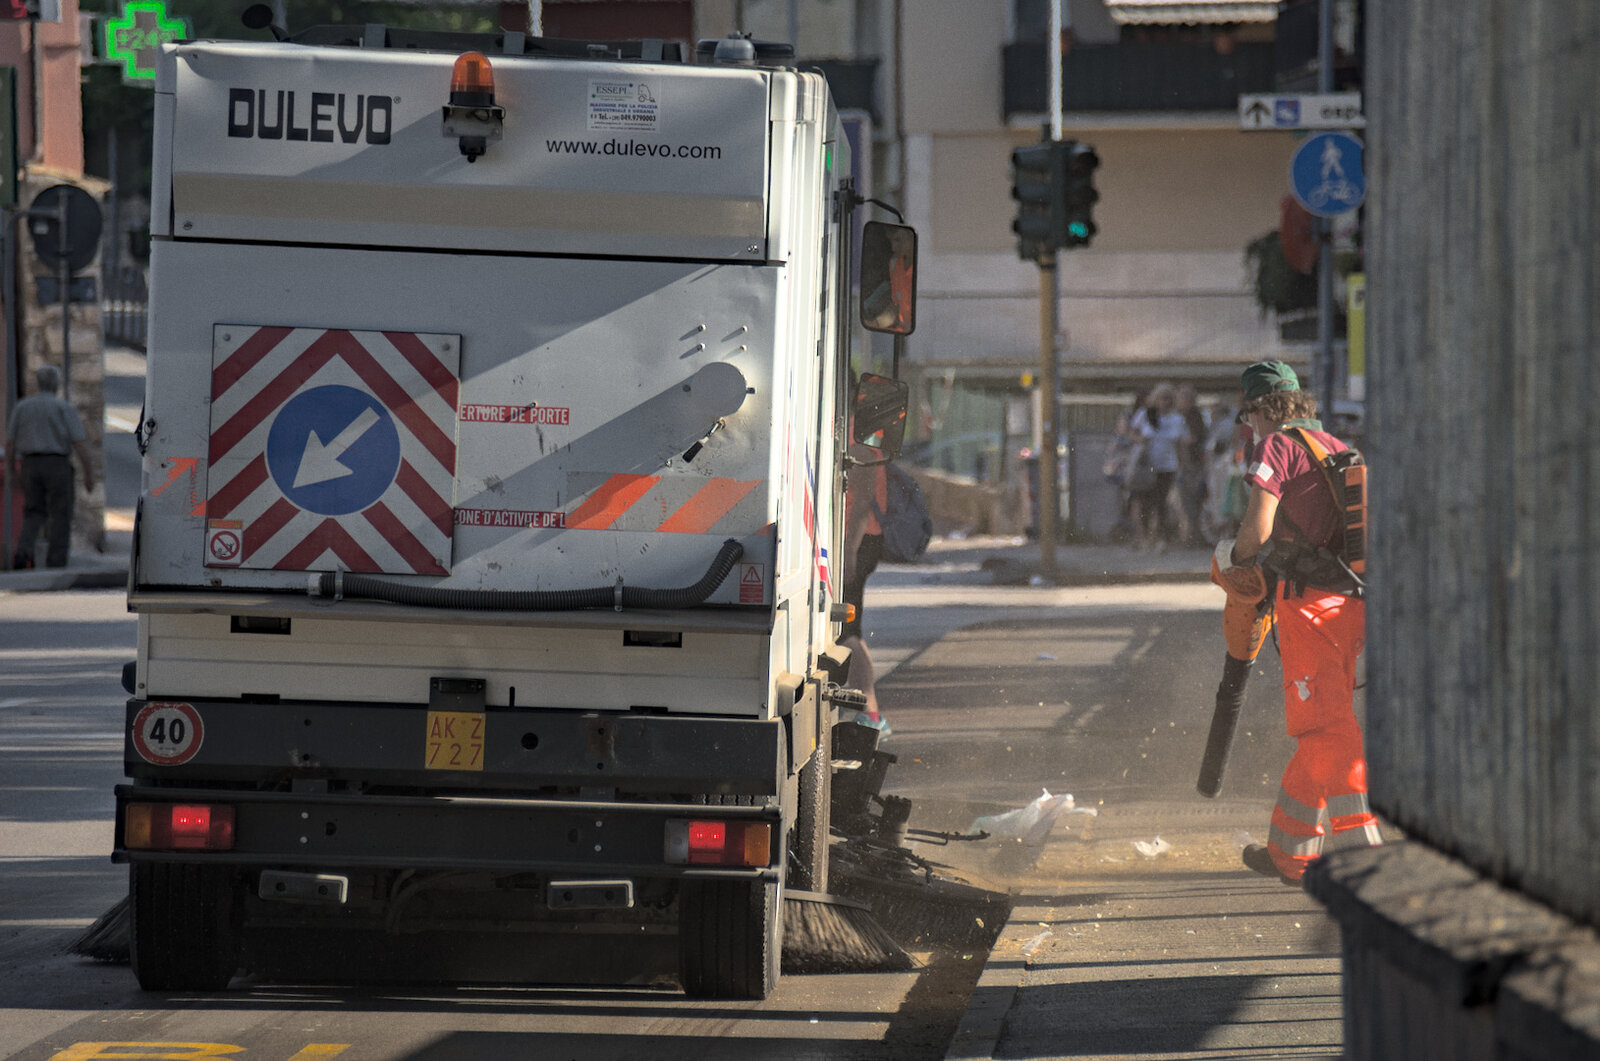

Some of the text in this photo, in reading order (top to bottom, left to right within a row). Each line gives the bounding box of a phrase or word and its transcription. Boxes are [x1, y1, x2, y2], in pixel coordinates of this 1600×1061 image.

[228, 88, 392, 145] DULEVO
[546, 139, 721, 159] www.dulevo.com
[510, 408, 526, 422] DE
[530, 408, 568, 424] PORTE
[542, 513, 556, 527] DE
[150, 718, 185, 744] 40
